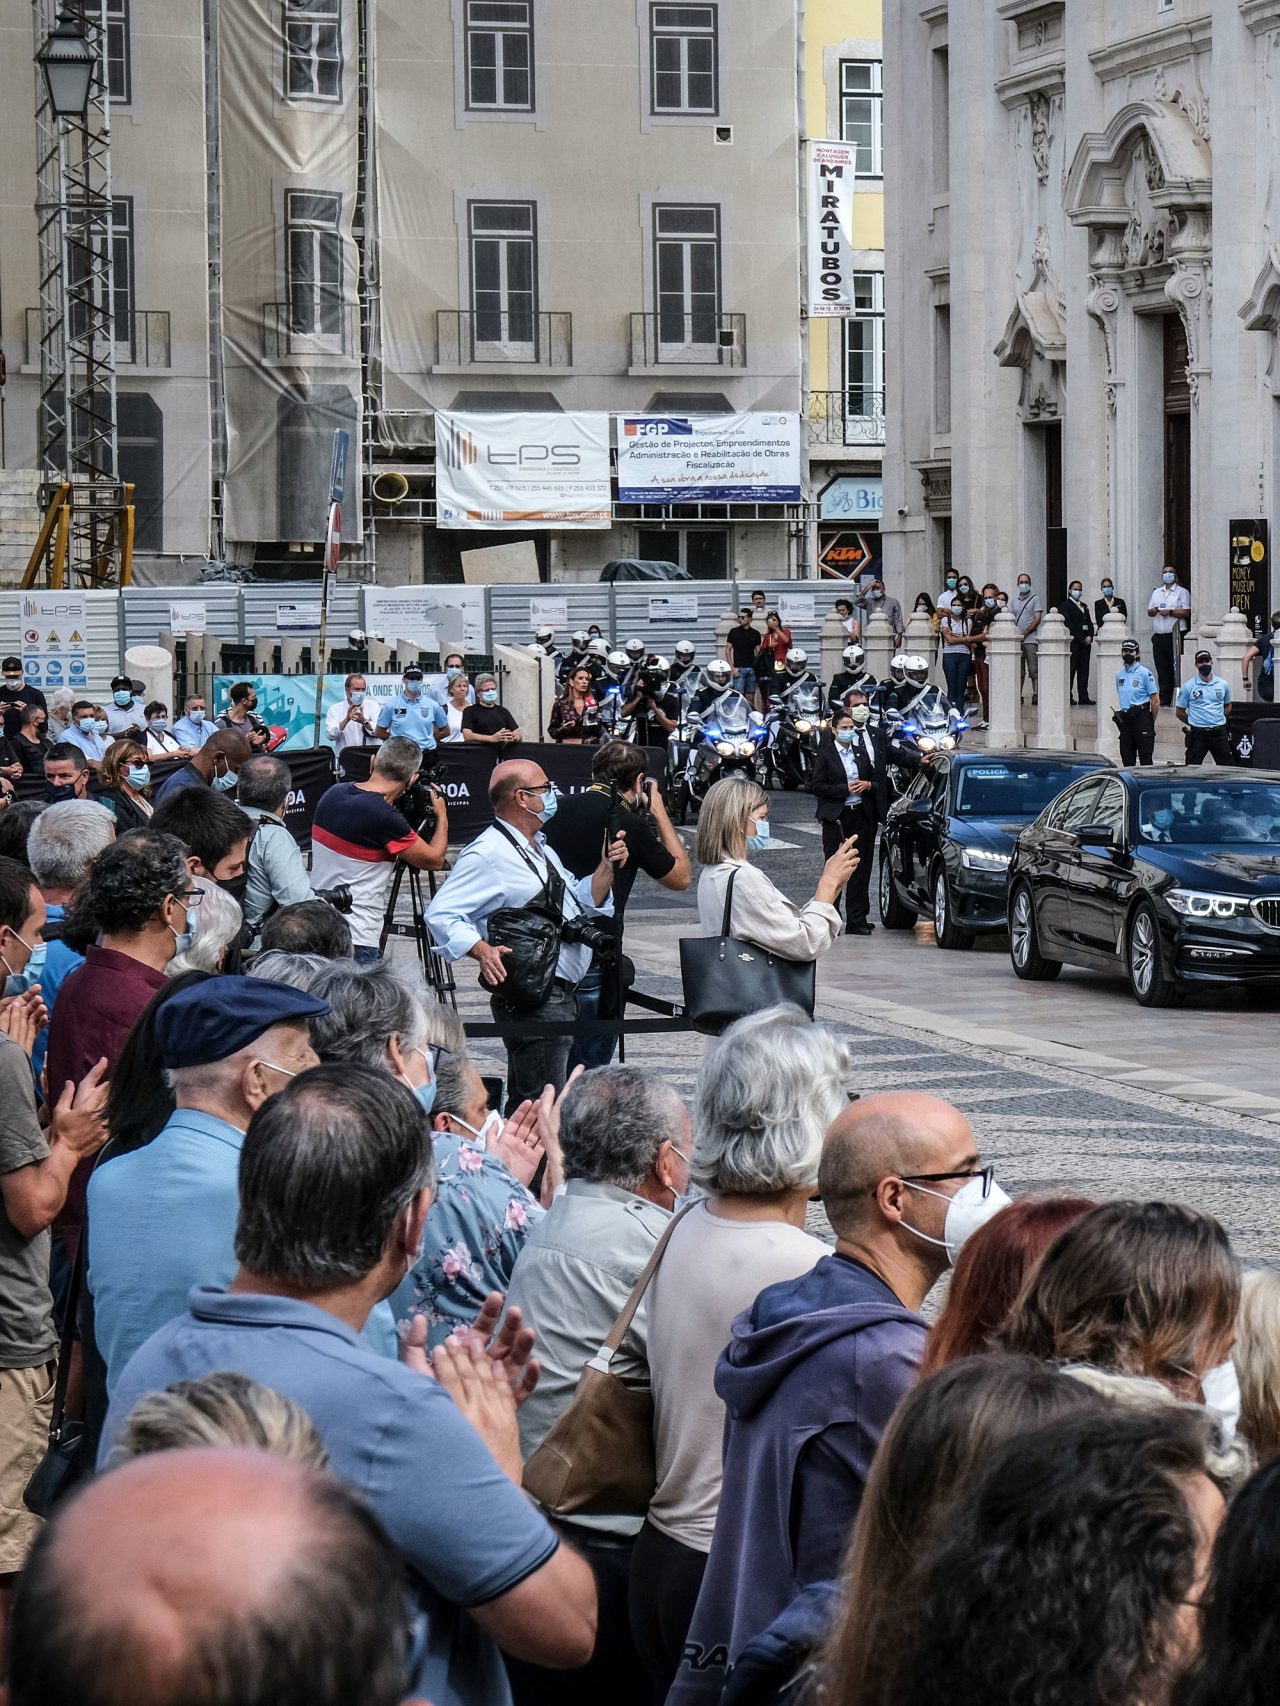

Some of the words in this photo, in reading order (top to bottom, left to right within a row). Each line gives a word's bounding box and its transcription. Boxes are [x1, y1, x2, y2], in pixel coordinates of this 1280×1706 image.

[820, 164, 844, 301] MIRATUBOS
[629, 440, 659, 449] Gestão
[661, 440, 671, 448] de
[716, 439, 791, 448] Empreendimentos
[752, 450, 762, 458] de
[764, 450, 790, 458] Obras
[827, 547, 863, 560] KTM
[1231, 567, 1251, 580] MONEY
[1231, 580, 1255, 592] MUSEUM
[1232, 594, 1250, 610] OPEN
[373, 685, 393, 697] ONDE
